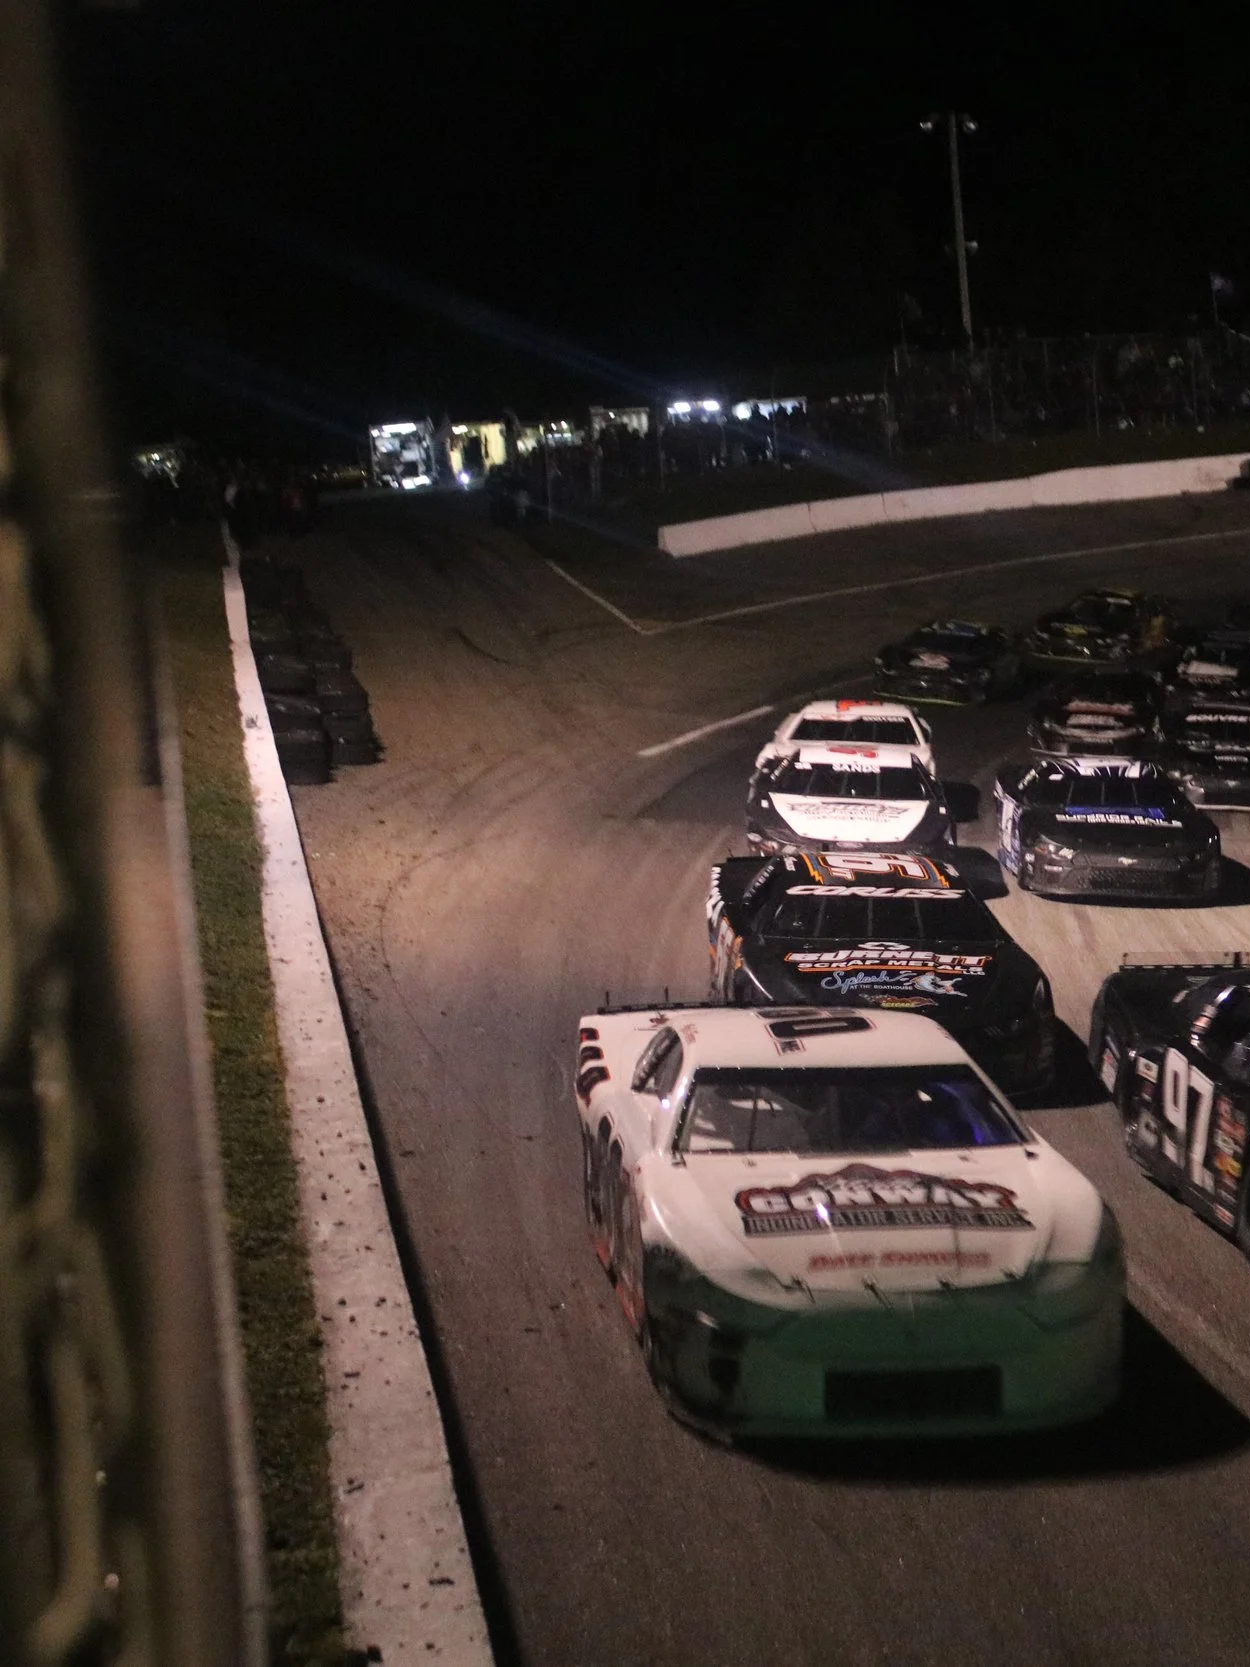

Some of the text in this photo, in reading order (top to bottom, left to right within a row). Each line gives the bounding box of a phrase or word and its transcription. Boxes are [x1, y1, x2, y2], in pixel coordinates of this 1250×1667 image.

[785, 885, 966, 899] CORLISS
[786, 950, 987, 967] BURNETT
[797, 959, 984, 976] SCRAP METALS
[1162, 1046, 1215, 1195] 97
[746, 1177, 1008, 1213] CONWAY
